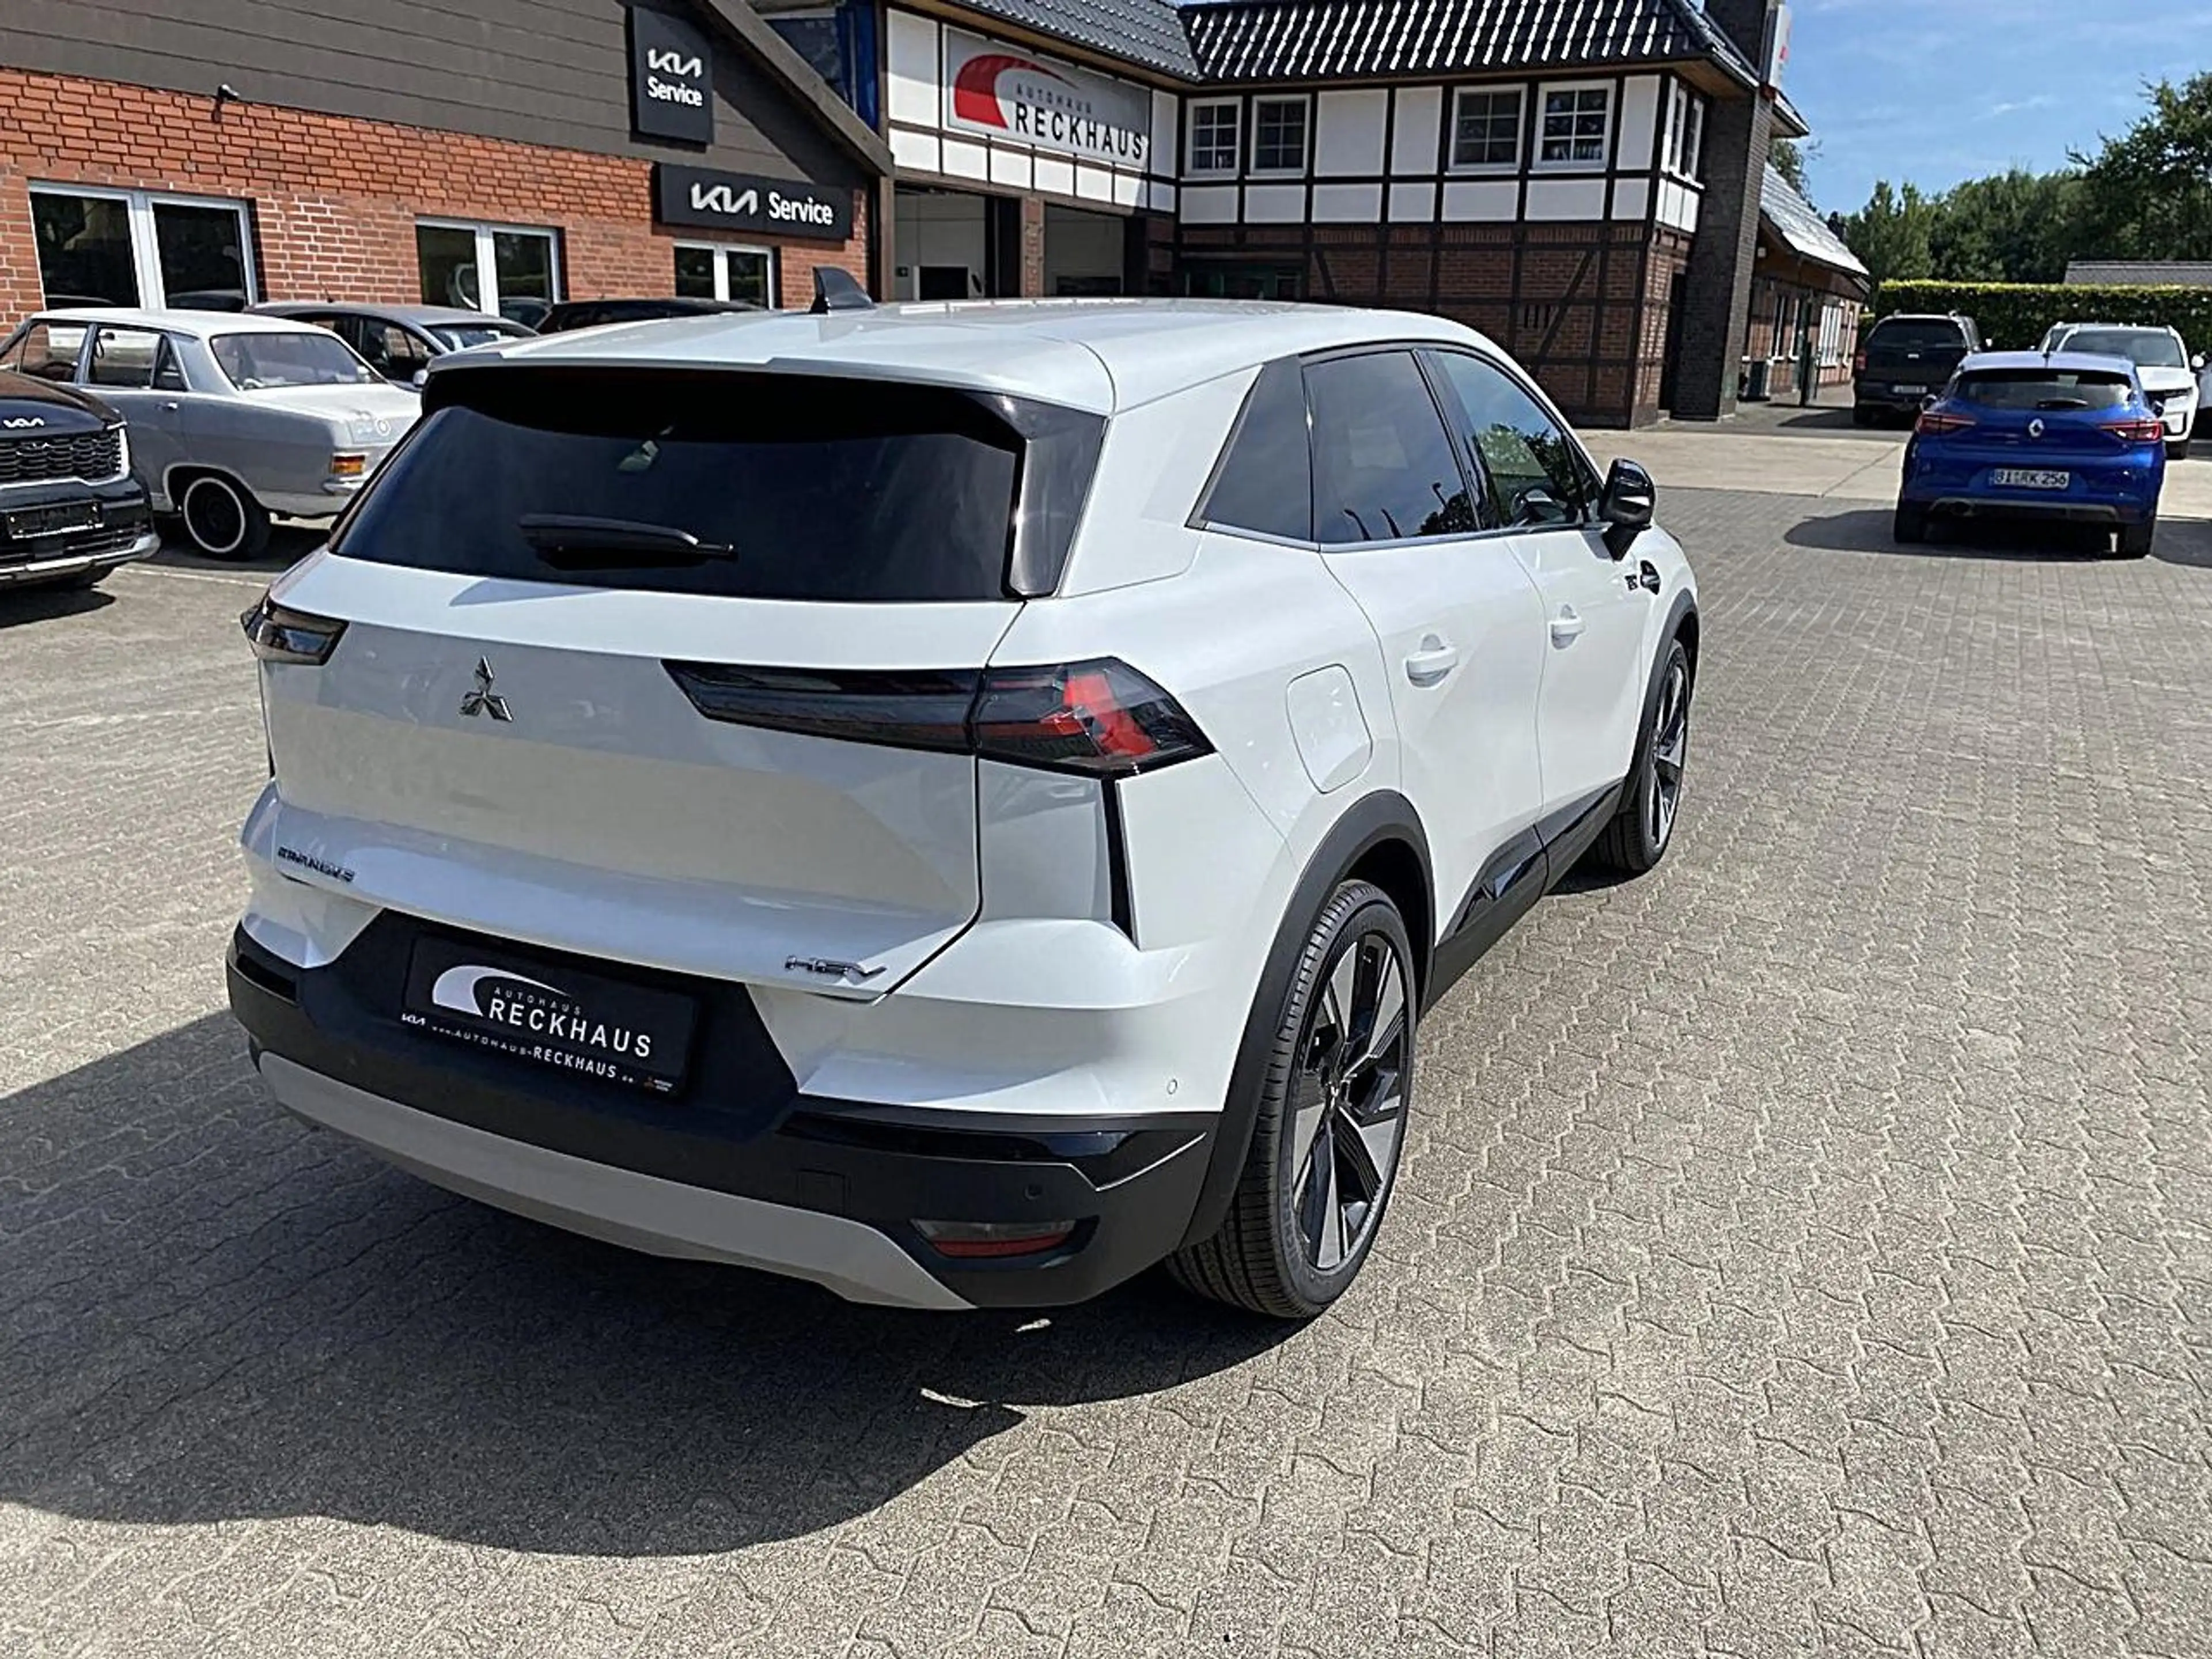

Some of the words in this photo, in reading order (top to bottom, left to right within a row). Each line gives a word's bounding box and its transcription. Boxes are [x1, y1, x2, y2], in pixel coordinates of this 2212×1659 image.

[647, 48, 702, 77] KIA
[647, 76, 703, 106] Service
[1016, 83, 1092, 113] AUTOHAUS
[1016, 103, 1142, 160] RECKHAUS
[691, 183, 758, 215] KIA
[768, 191, 833, 225] Service
[494, 987, 582, 1016] AUTOHAUS
[488, 998, 652, 1058] RECKHAUS
